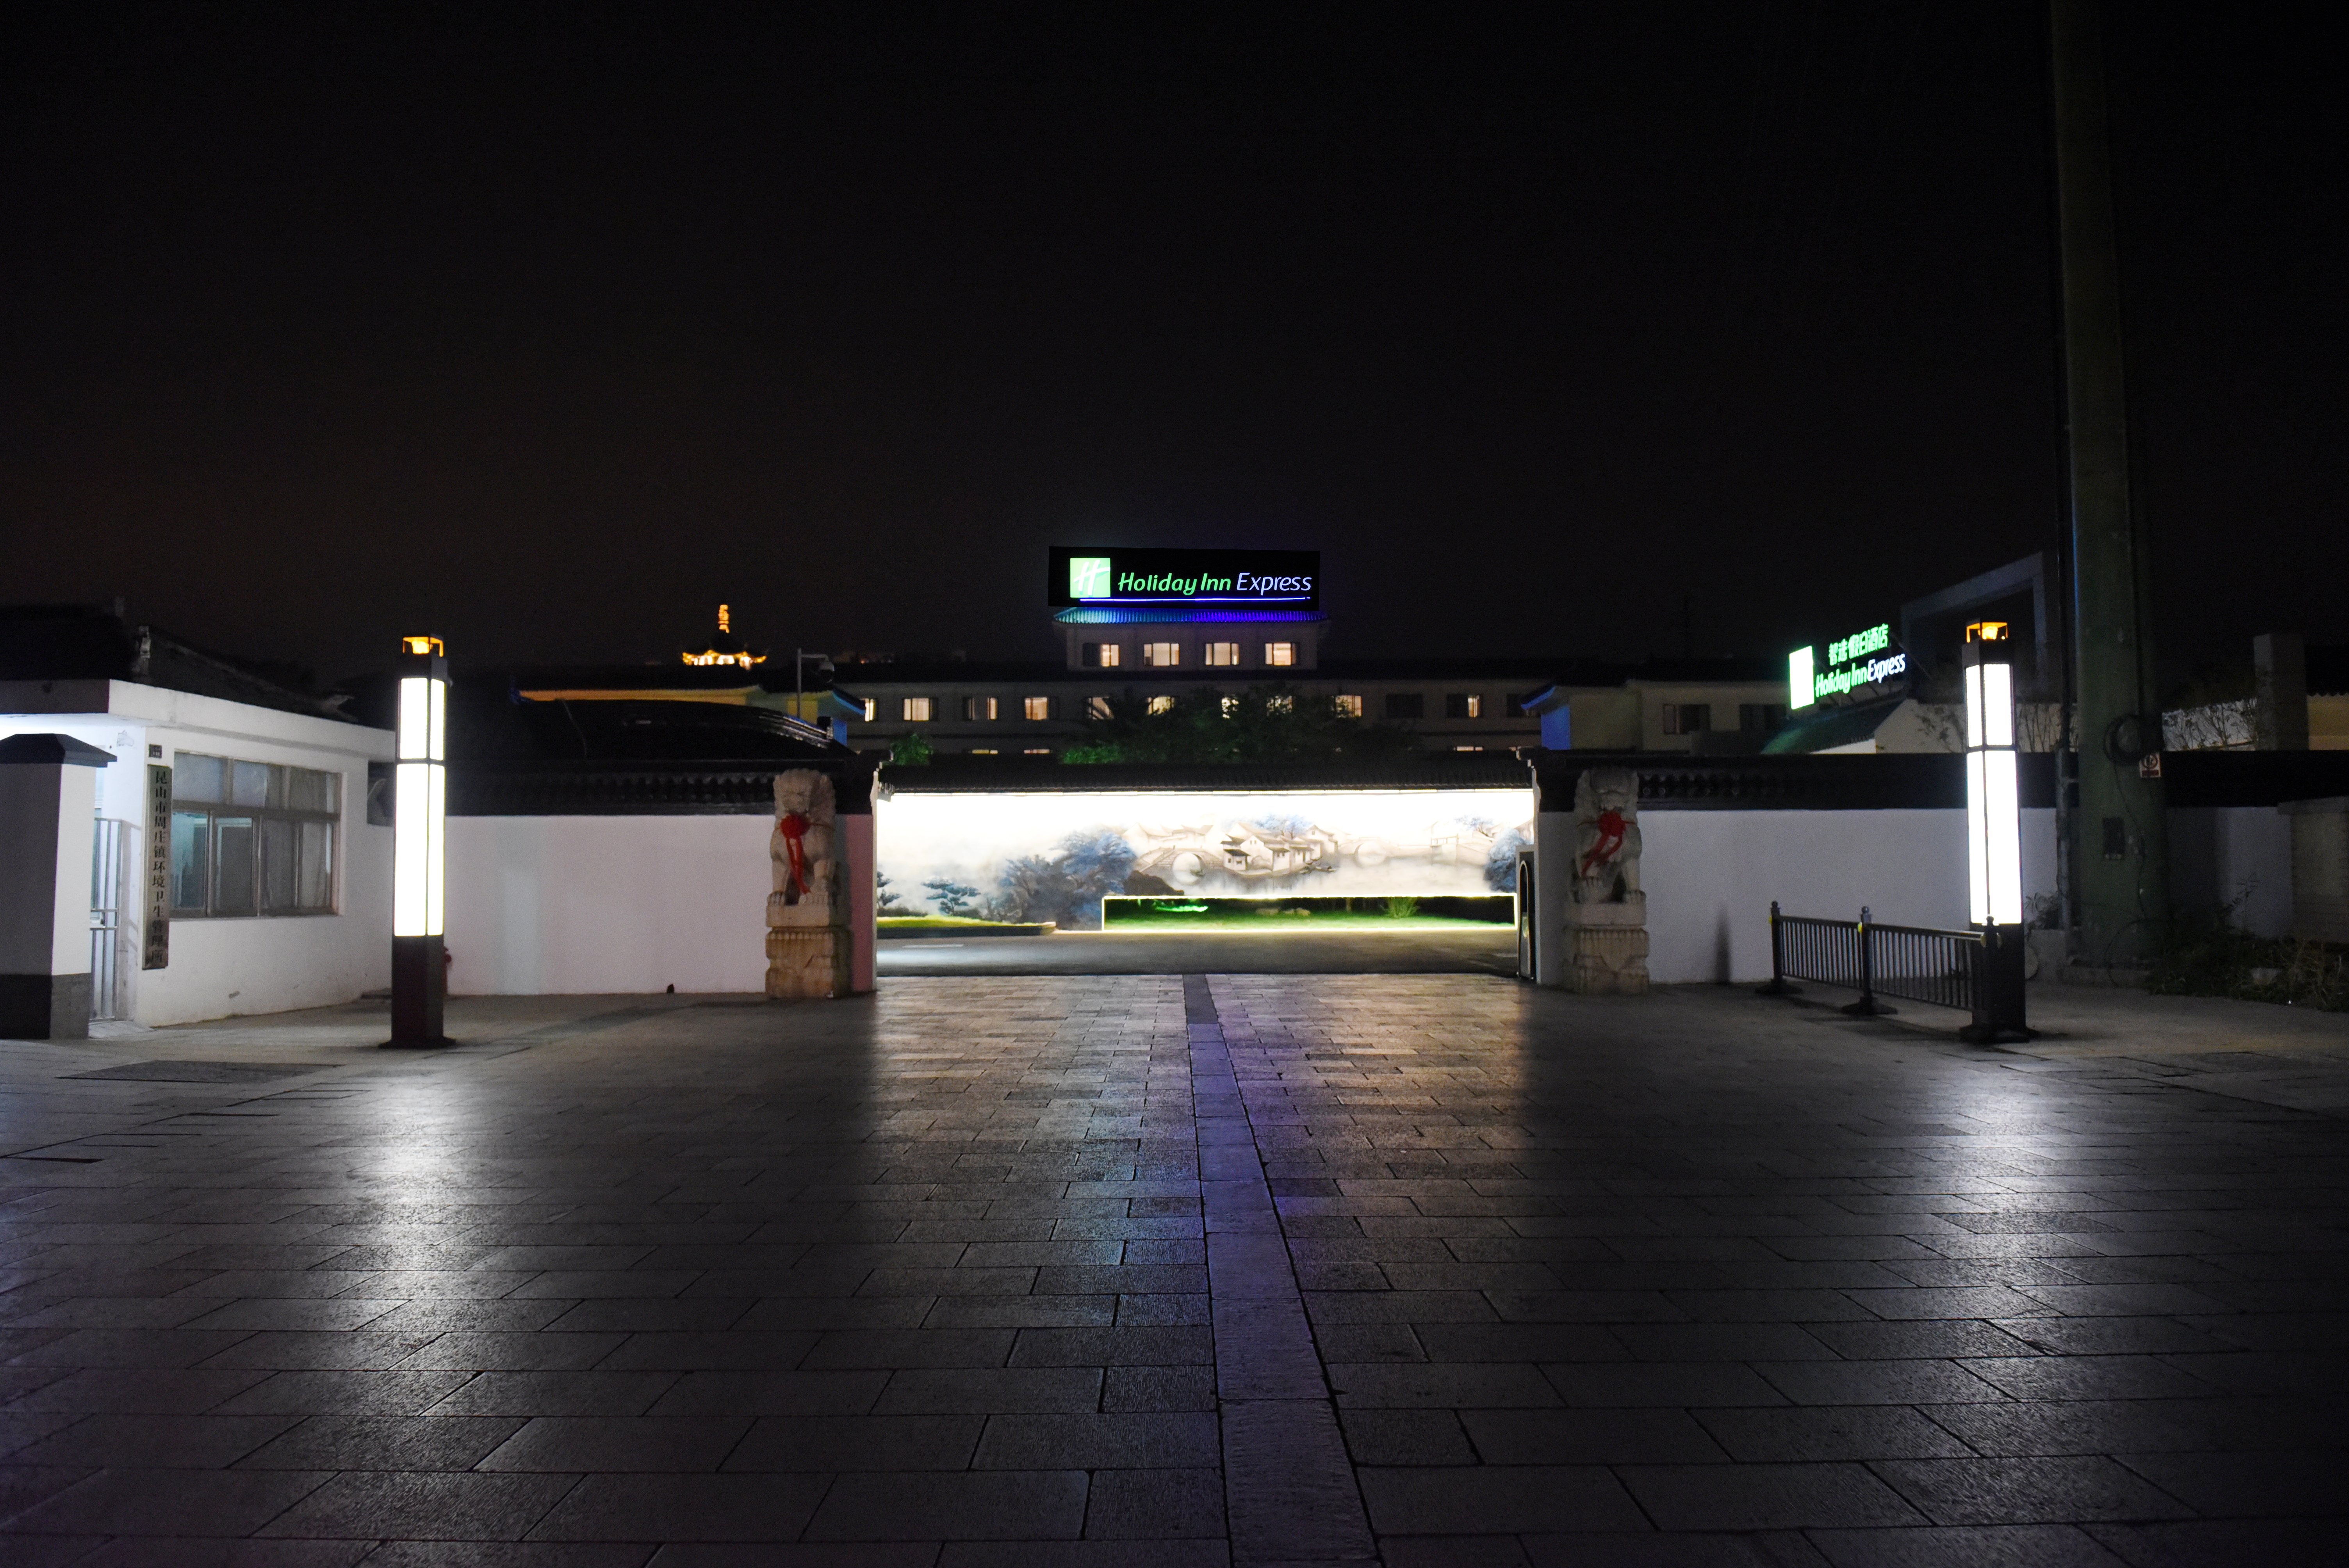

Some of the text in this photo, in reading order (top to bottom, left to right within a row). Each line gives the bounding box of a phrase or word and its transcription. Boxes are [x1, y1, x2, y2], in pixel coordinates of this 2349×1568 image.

[1118, 572, 1312, 596] Holiday Inn Express
[1828, 623, 1889, 666] 智选假日酒店
[1815, 653, 1906, 698] Holiday Inn Express
[151, 770, 168, 963] 昆山市周庄镇环境卫生管理所
